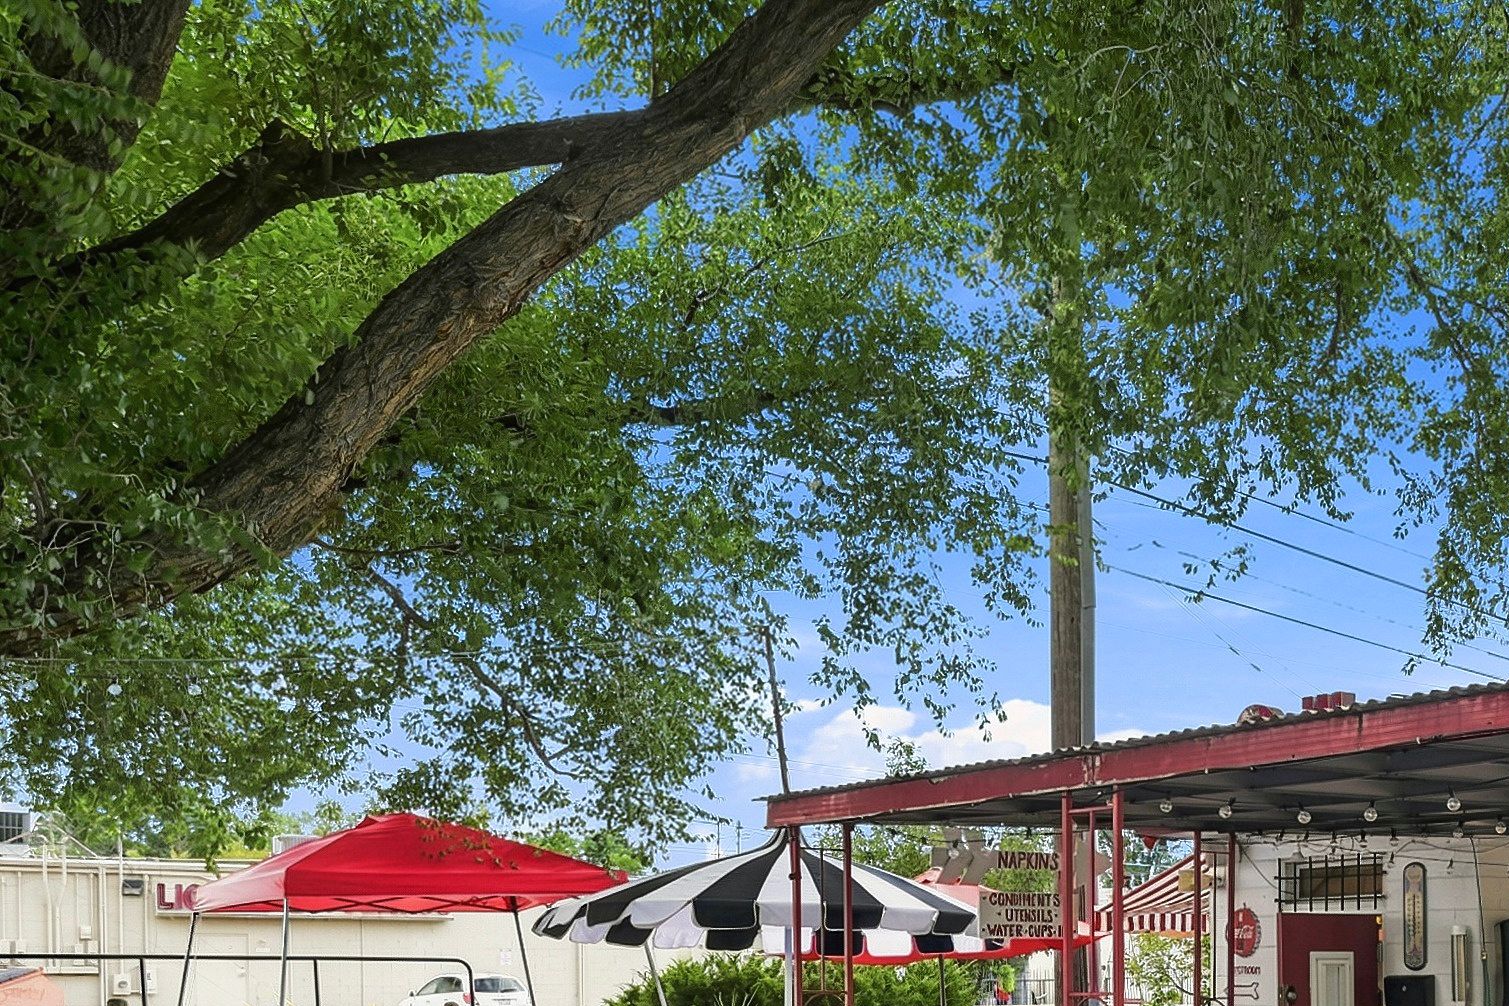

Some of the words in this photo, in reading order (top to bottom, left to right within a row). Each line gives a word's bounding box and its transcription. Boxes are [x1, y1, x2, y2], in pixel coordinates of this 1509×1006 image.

[997, 850, 1059, 871] NAPKINS
[988, 892, 1061, 907] CONDIMENTS
[1005, 908, 1053, 923] UTENSILS
[986, 924, 1023, 937] WATER
[1028, 924, 1054, 938] CUPS
